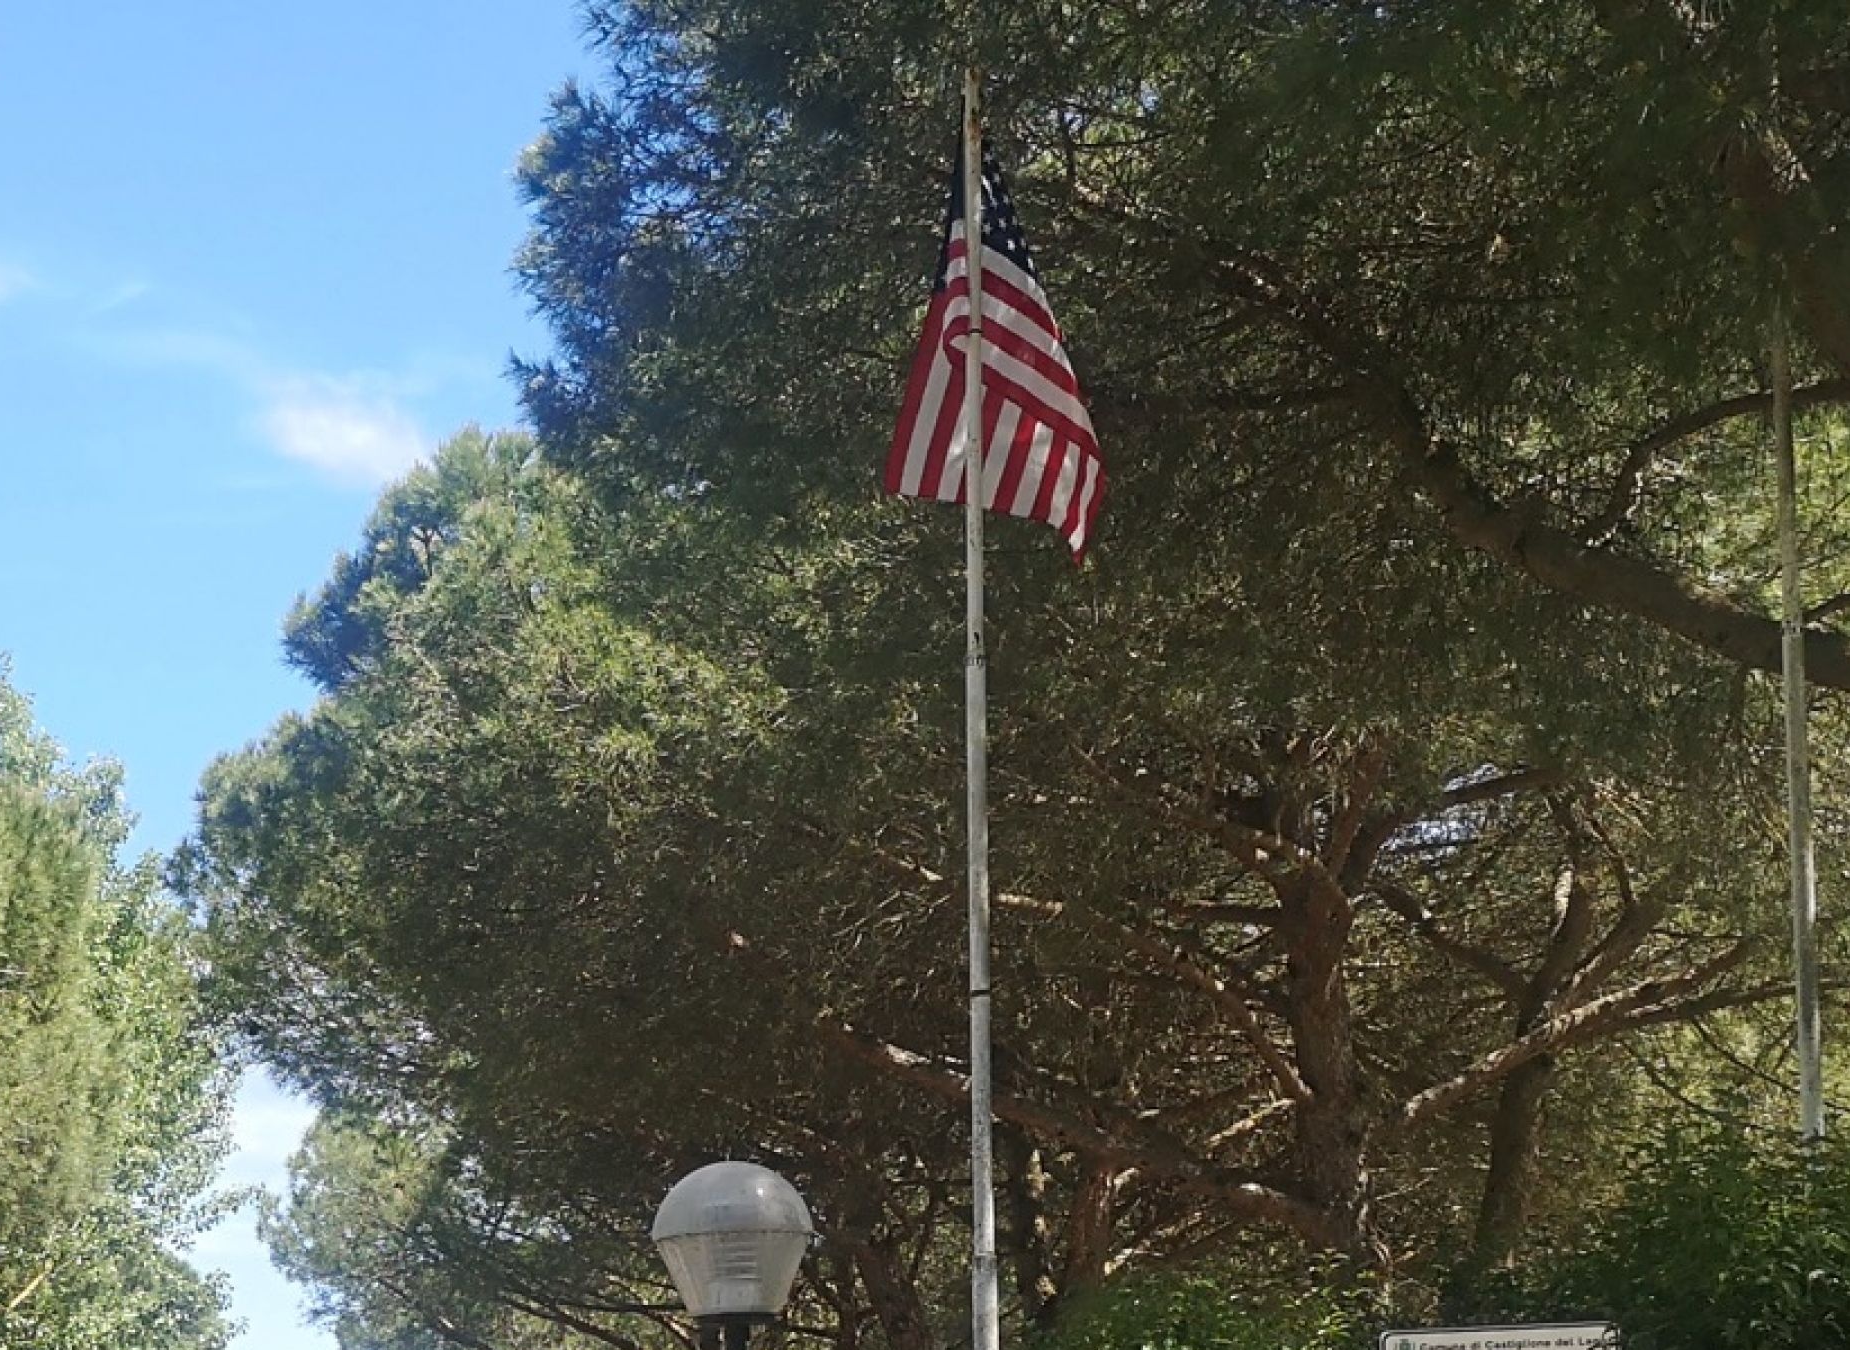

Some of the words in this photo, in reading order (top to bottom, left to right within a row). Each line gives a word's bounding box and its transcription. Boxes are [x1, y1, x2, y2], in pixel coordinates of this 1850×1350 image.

[1471, 1341, 1481, 1350] di
[1484, 1338, 1551, 1350] Castiglione
[1554, 1337, 1574, 1347] del
